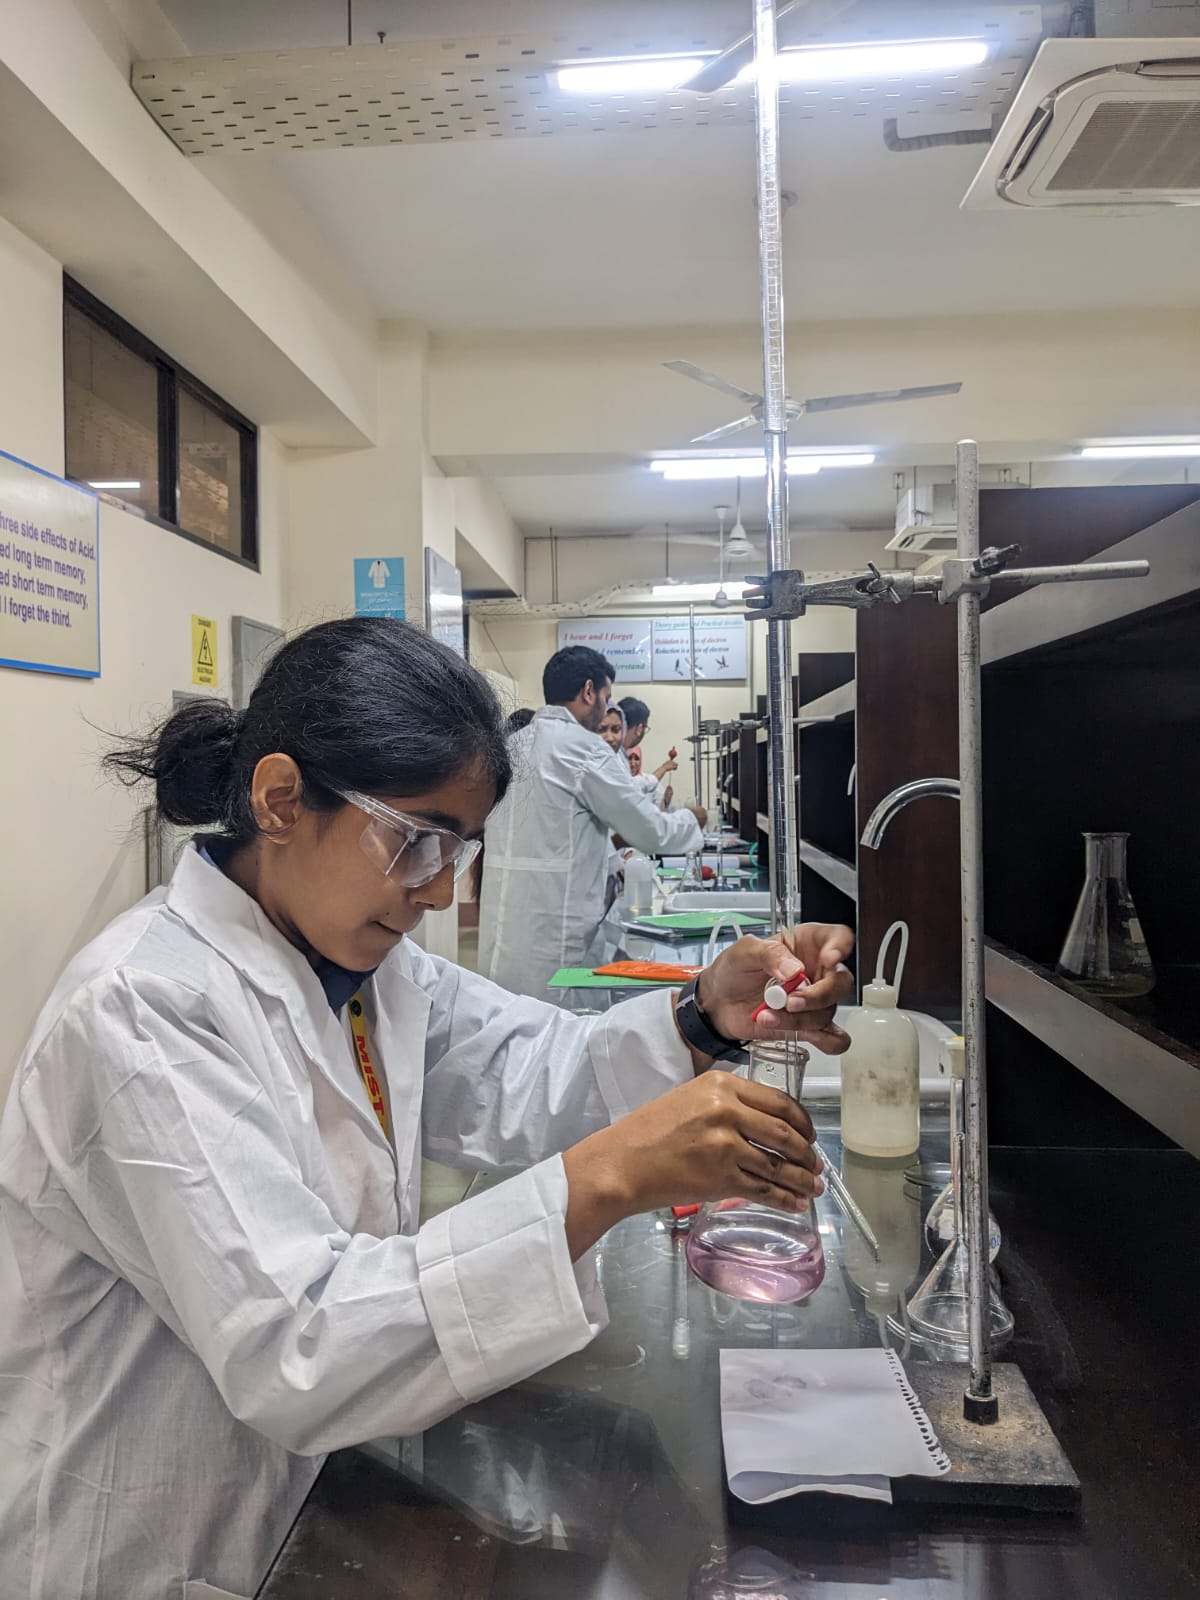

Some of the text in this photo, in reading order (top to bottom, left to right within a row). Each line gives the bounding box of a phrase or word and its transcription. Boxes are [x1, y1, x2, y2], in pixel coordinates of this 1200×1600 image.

[21, 520, 39, 541] side
[41, 528, 68, 551] effects
[69, 538, 77, 553] of
[79, 540, 96, 560] Acid.
[13, 543, 32, 570] long
[34, 551, 53, 572] term
[54, 560, 86, 585] memory,
[12, 572, 35, 593] short
[36, 579, 55, 598] term
[57, 587, 88, 610] memory,
[9, 597, 35, 623] forget
[37, 604, 50, 623] the
[52, 608, 72, 628] third.
[589, 632, 603, 640] and
[610, 632, 633, 642] forget
[356, 1034, 385, 1116] MIST
